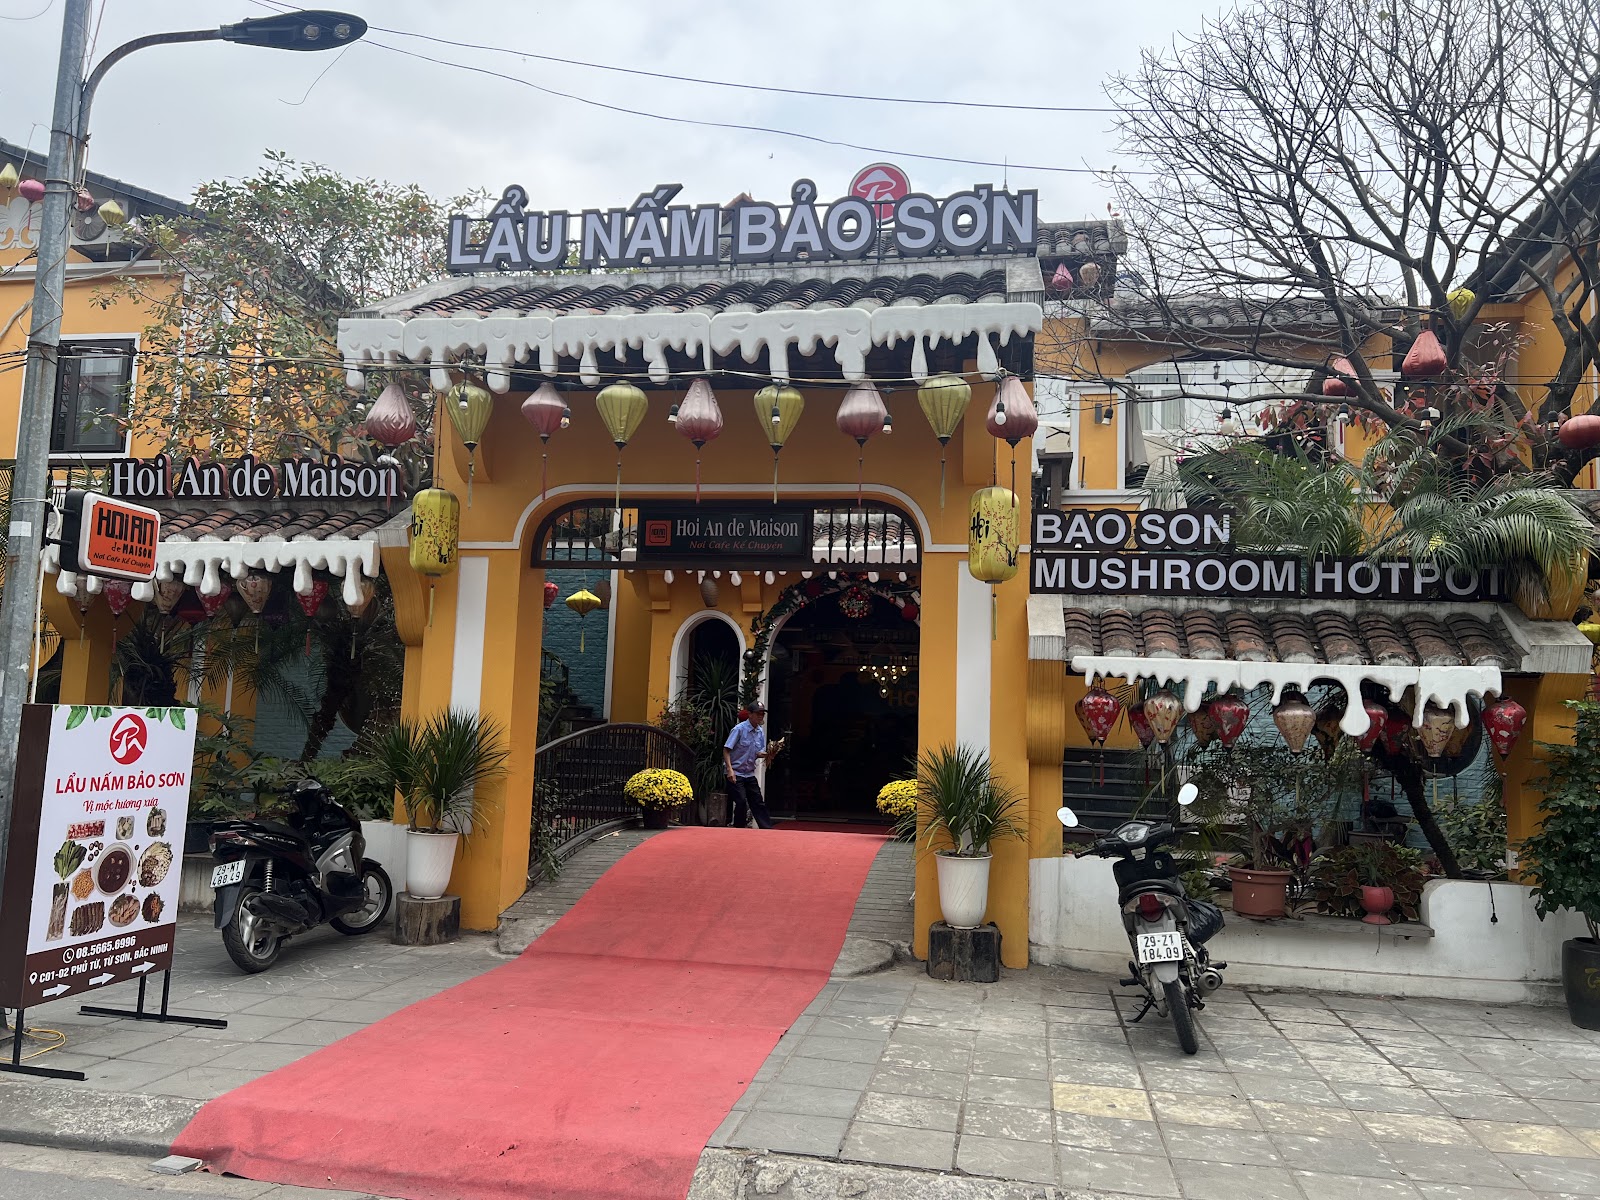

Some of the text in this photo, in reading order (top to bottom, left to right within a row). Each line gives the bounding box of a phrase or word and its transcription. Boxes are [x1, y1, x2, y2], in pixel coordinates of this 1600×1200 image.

[449, 183, 1033, 267] LẨU NẤM BẢO SƠN
[111, 457, 399, 497] Hoi An de Maison
[676, 517, 700, 537] Hoi
[703, 518, 724, 537] An
[727, 517, 745, 537] de
[749, 517, 799, 537] Maison
[1035, 513, 1231, 545] BAO SON
[111, 541, 153, 559] de MAISON
[708, 540, 731, 550] Cafe
[106, 554, 121, 563] Cafe
[1034, 557, 1503, 596] MUSHROOM HOTPOT
[55, 770, 185, 794] LẨU NẤM BẢO SƠN
[75, 935, 137, 960] 08.5665.6996
[1143, 933, 1175, 948] 29-Z1
[39, 967, 69, 983] C01-02
[150, 942, 169, 955] NINH
[1142, 946, 1180, 961] 184.09
